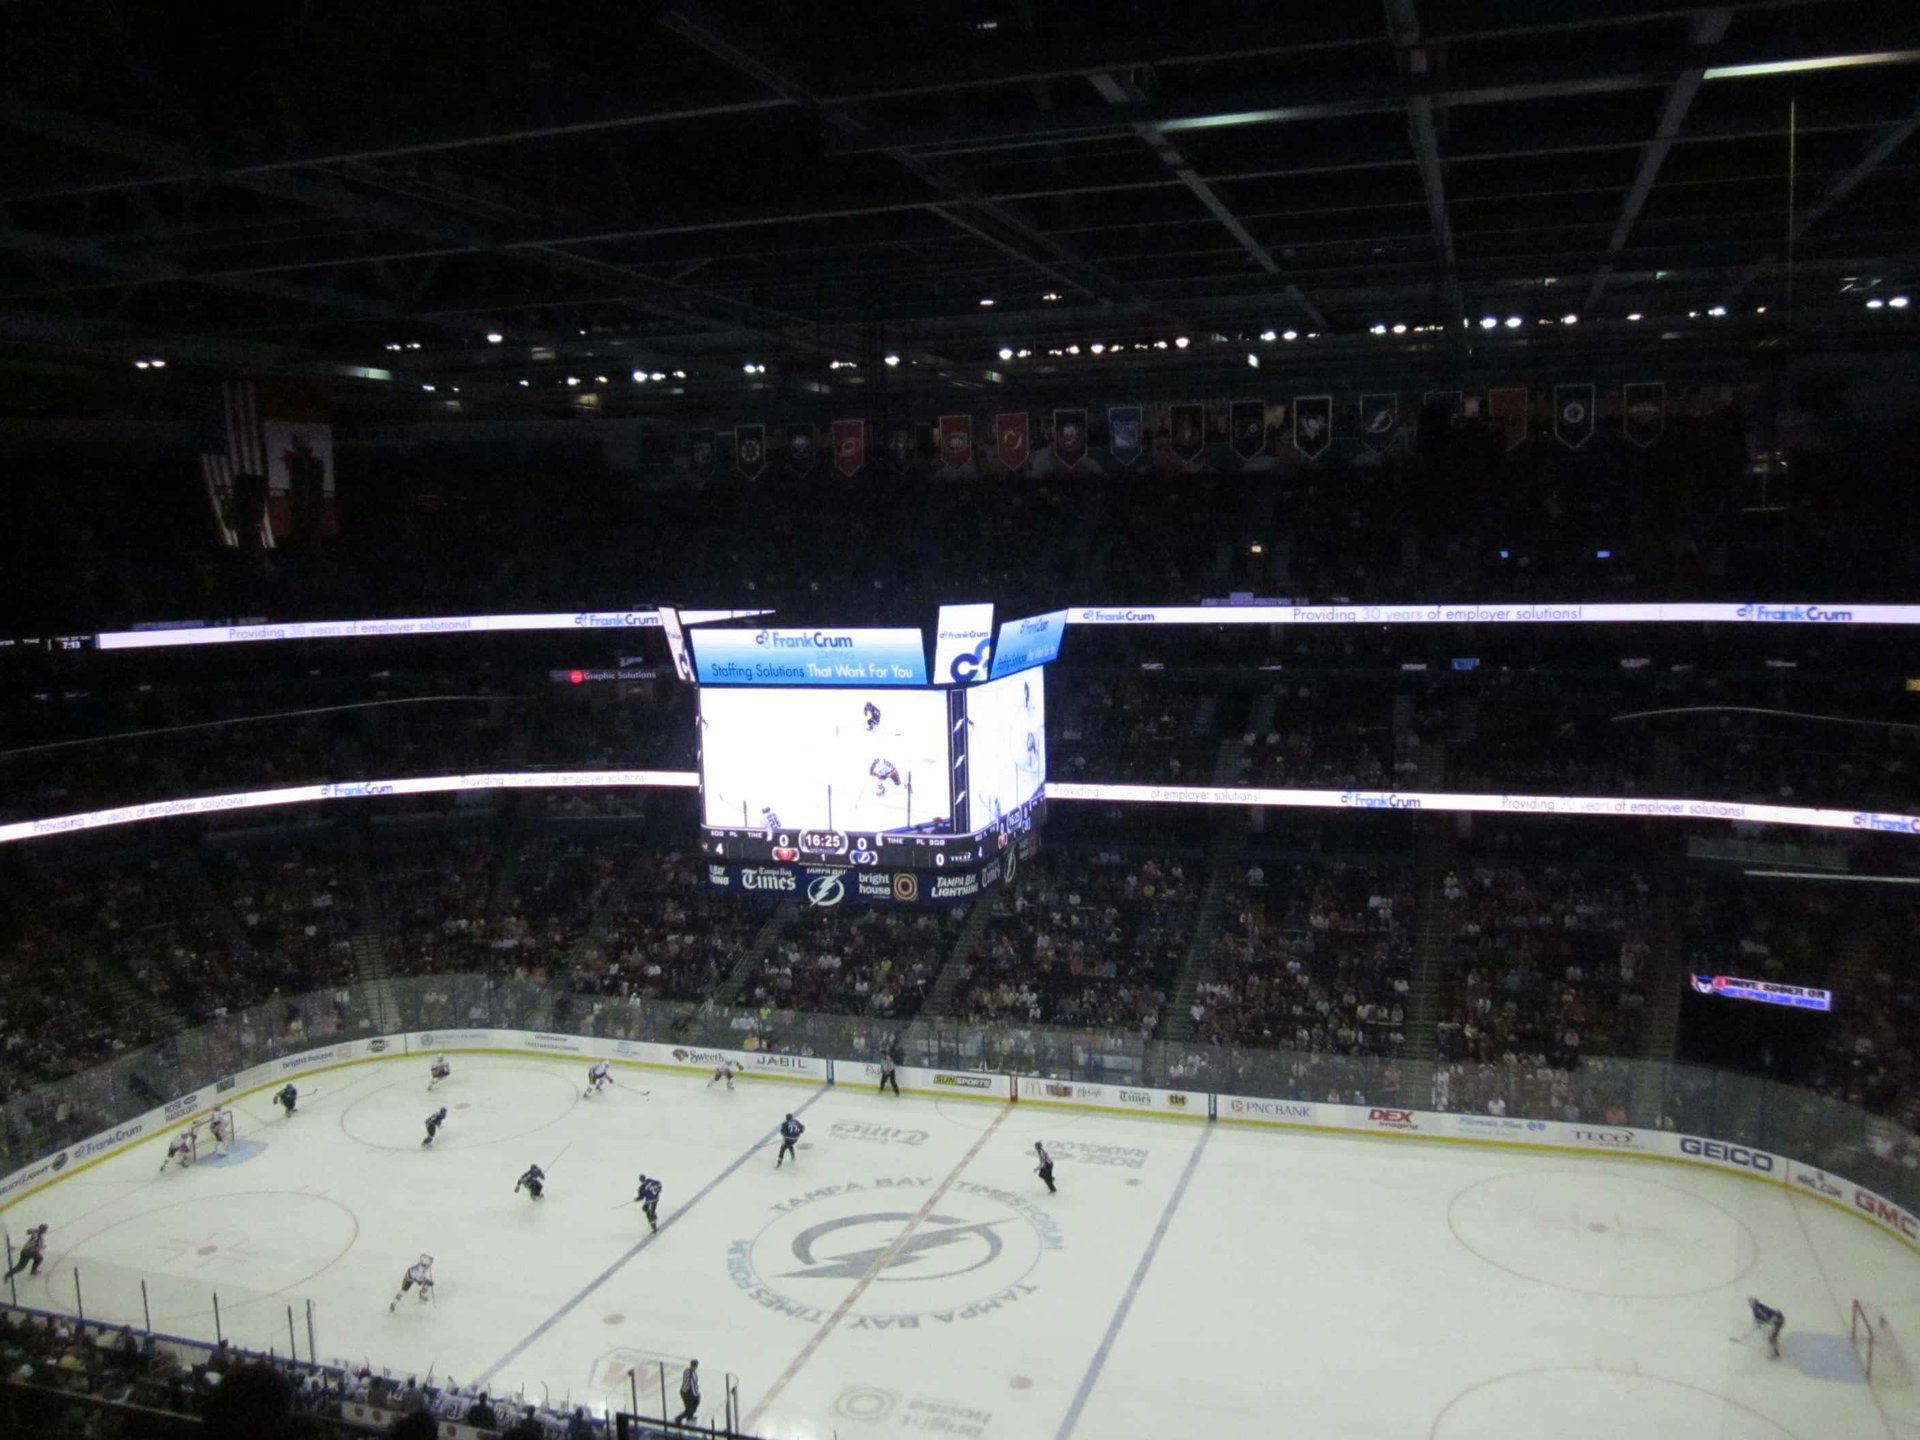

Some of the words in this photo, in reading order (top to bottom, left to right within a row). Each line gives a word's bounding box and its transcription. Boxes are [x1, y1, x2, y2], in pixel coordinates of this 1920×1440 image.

[589, 614, 659, 626] FrankCrum
[1095, 611, 1155, 621] FrankCrum
[1293, 607, 1356, 622] Providing
[1362, 608, 1381, 620] 30
[1386, 609, 1423, 622] years
[1427, 605, 1441, 620] of
[1446, 605, 1510, 621] employer
[1516, 605, 1582, 619] solutions!
[1757, 606, 1852, 621] FrankCrum
[229, 628, 285, 640] Providing
[290, 626, 305, 636] 30
[346, 623, 358, 634] of
[361, 622, 414, 635] employer
[419, 619, 472, 631] solutions!
[948, 631, 989, 639] FrankCrum
[773, 632, 853, 648] FrankCrum
[584, 672, 615, 681] Graphic
[617, 671, 656, 680] Solutions
[712, 663, 752, 680] Staffing
[756, 663, 804, 678] Solutions
[807, 663, 832, 678] That
[835, 664, 866, 678] Work
[869, 665, 887, 678] For
[891, 665, 912, 678] You
[334, 782, 393, 797] FrankCrum
[1150, 789, 1160, 799] of
[1164, 789, 1211, 801] employer
[1355, 794, 1421, 808] FrankCrum
[1502, 796, 1555, 812] Providing
[1615, 802, 1626, 812] of
[1630, 802, 1684, 815] employer
[148, 801, 197, 817] employer
[779, 835, 789, 847] 0
[805, 834, 840, 848] 16:25
[857, 838, 867, 850] 0
[715, 843, 723, 855] 4
[936, 853, 944, 866] 0
[741, 868, 797, 891] Times
[858, 872, 890, 884] bright
[936, 876, 964, 888] TAMPA
[965, 874, 977, 886] BAY
[859, 885, 891, 895] house
[931, 883, 978, 898] LIGHTNING
[757, 1057, 807, 1069] JABIL
[934, 1074, 955, 1085] SUN
[956, 1076, 990, 1087] SPORTS
[1119, 1090, 1151, 1104] Times
[788, 1124, 798, 1133] 77
[86, 1124, 143, 1156] FrankCrum
[1574, 1130, 1631, 1144] TECO
[1046, 1141, 1150, 1158] RADIOLOG
[1680, 1138, 1773, 1172] GEICO
[771, 1182, 864, 1213] TAMPA
[875, 1177, 933, 1187] BAY
[956, 1181, 1028, 1208] TIMES
[1029, 1204, 1065, 1250] FORUM
[1854, 1188, 1918, 1239] GMC
[727, 1240, 750, 1290] FORUM
[748, 1286, 825, 1324] TIMES
[933, 1283, 1039, 1324] TAMPA
[850, 1316, 920, 1329] BAY
